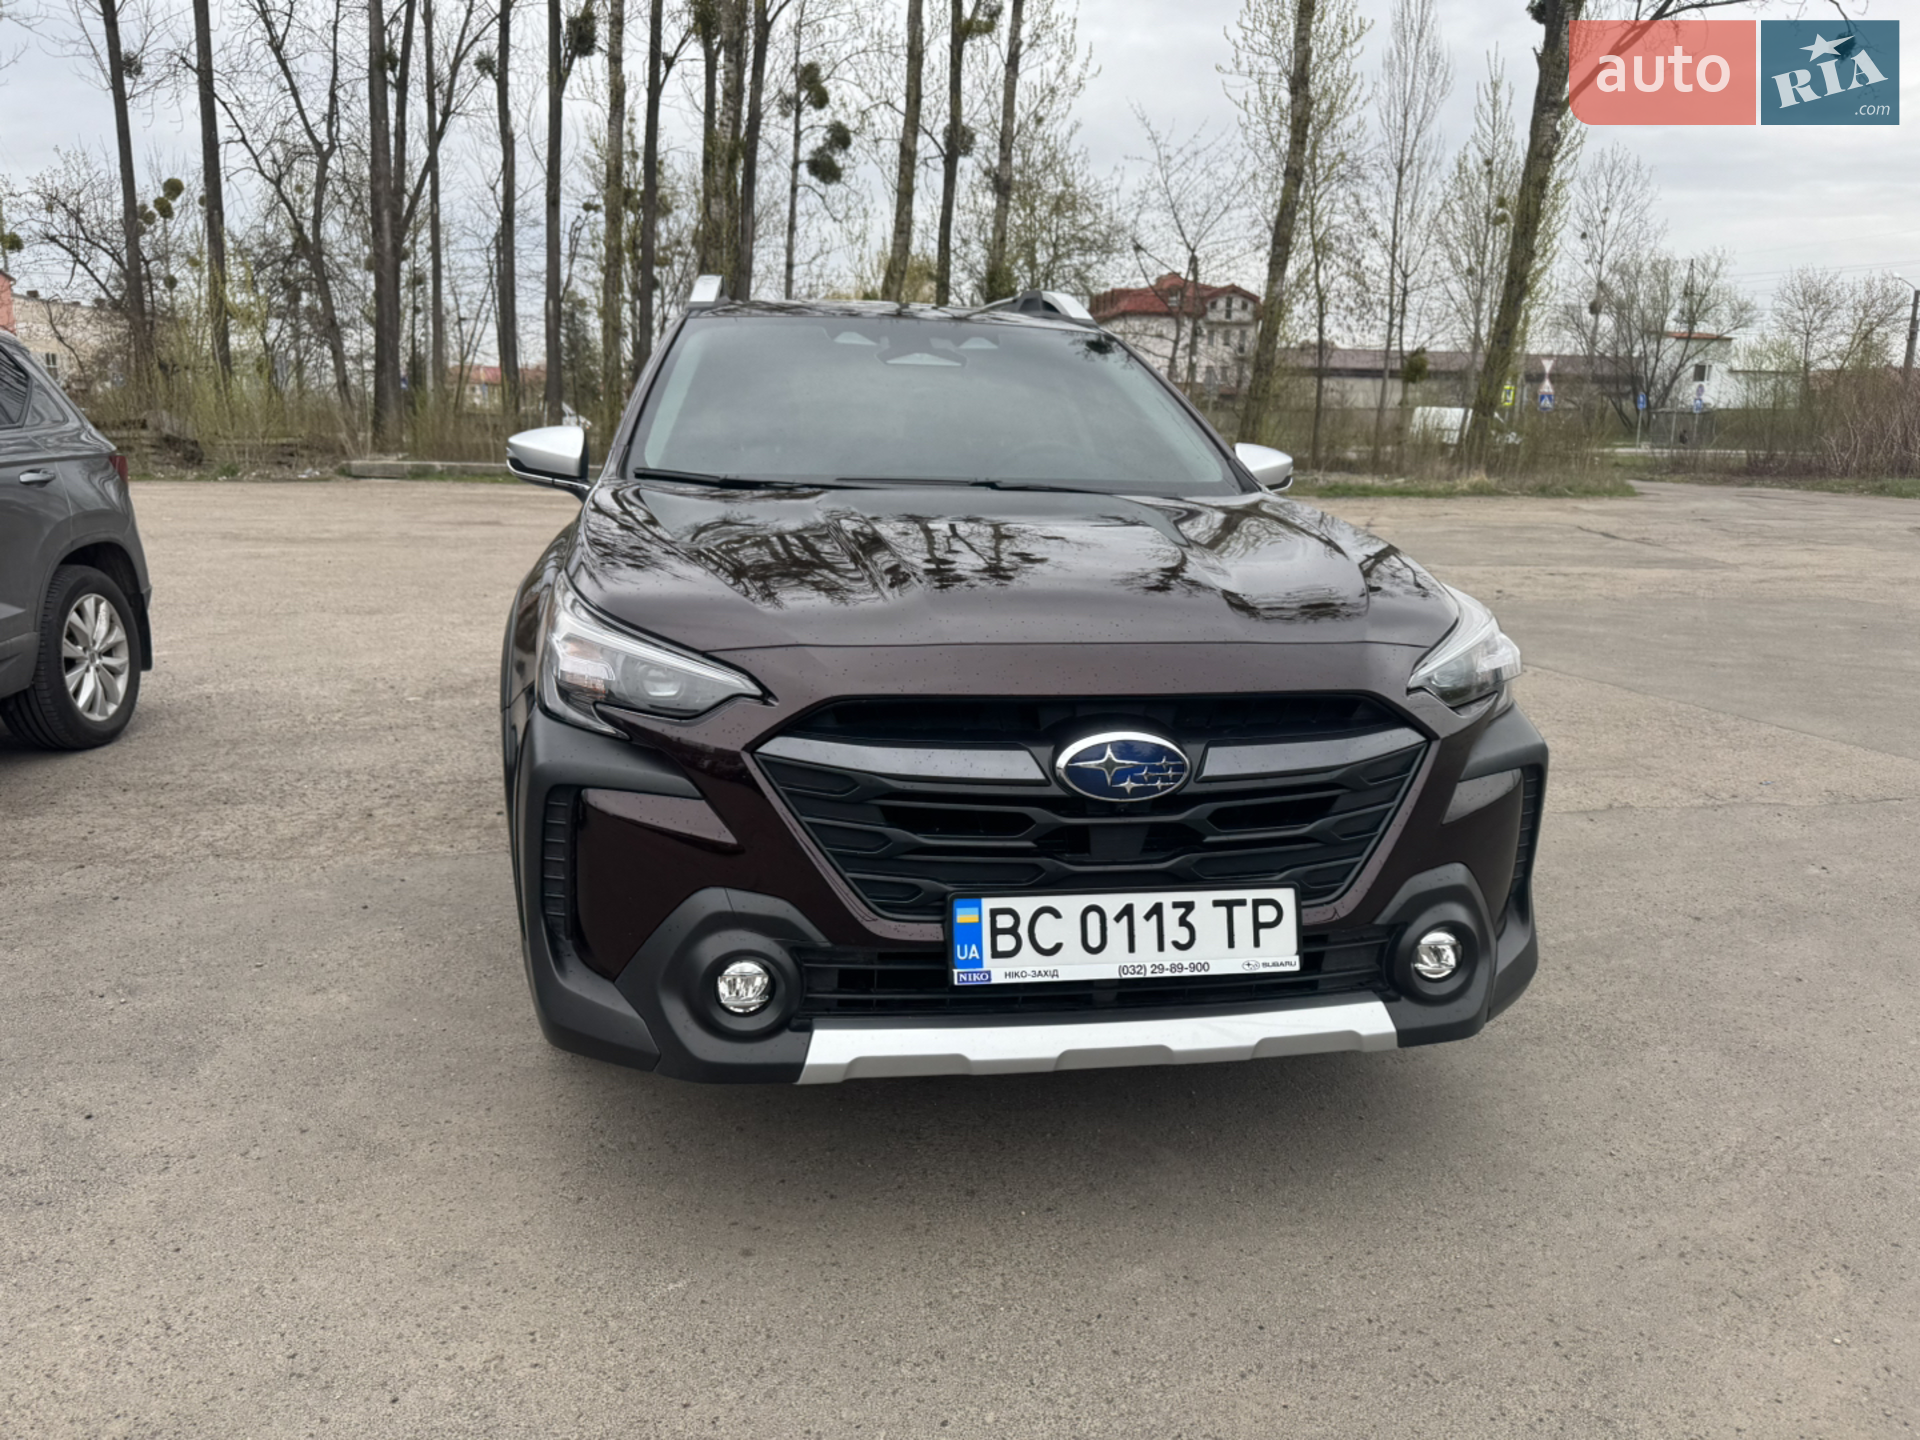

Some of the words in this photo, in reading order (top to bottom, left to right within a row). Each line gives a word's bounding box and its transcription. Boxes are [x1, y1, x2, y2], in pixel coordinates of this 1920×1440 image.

[989, 906, 1064, 959] BC
[1080, 901, 1197, 955] 0113
[1212, 898, 1284, 949] TP
[957, 945, 980, 960] UA
[1118, 965, 1147, 977] (032)
[1150, 962, 1210, 975] 29-89-900
[1261, 960, 1296, 969] SUBARU
[959, 972, 989, 982] NIKO
[1004, 969, 1059, 979] НІКО-ЗАХІД
